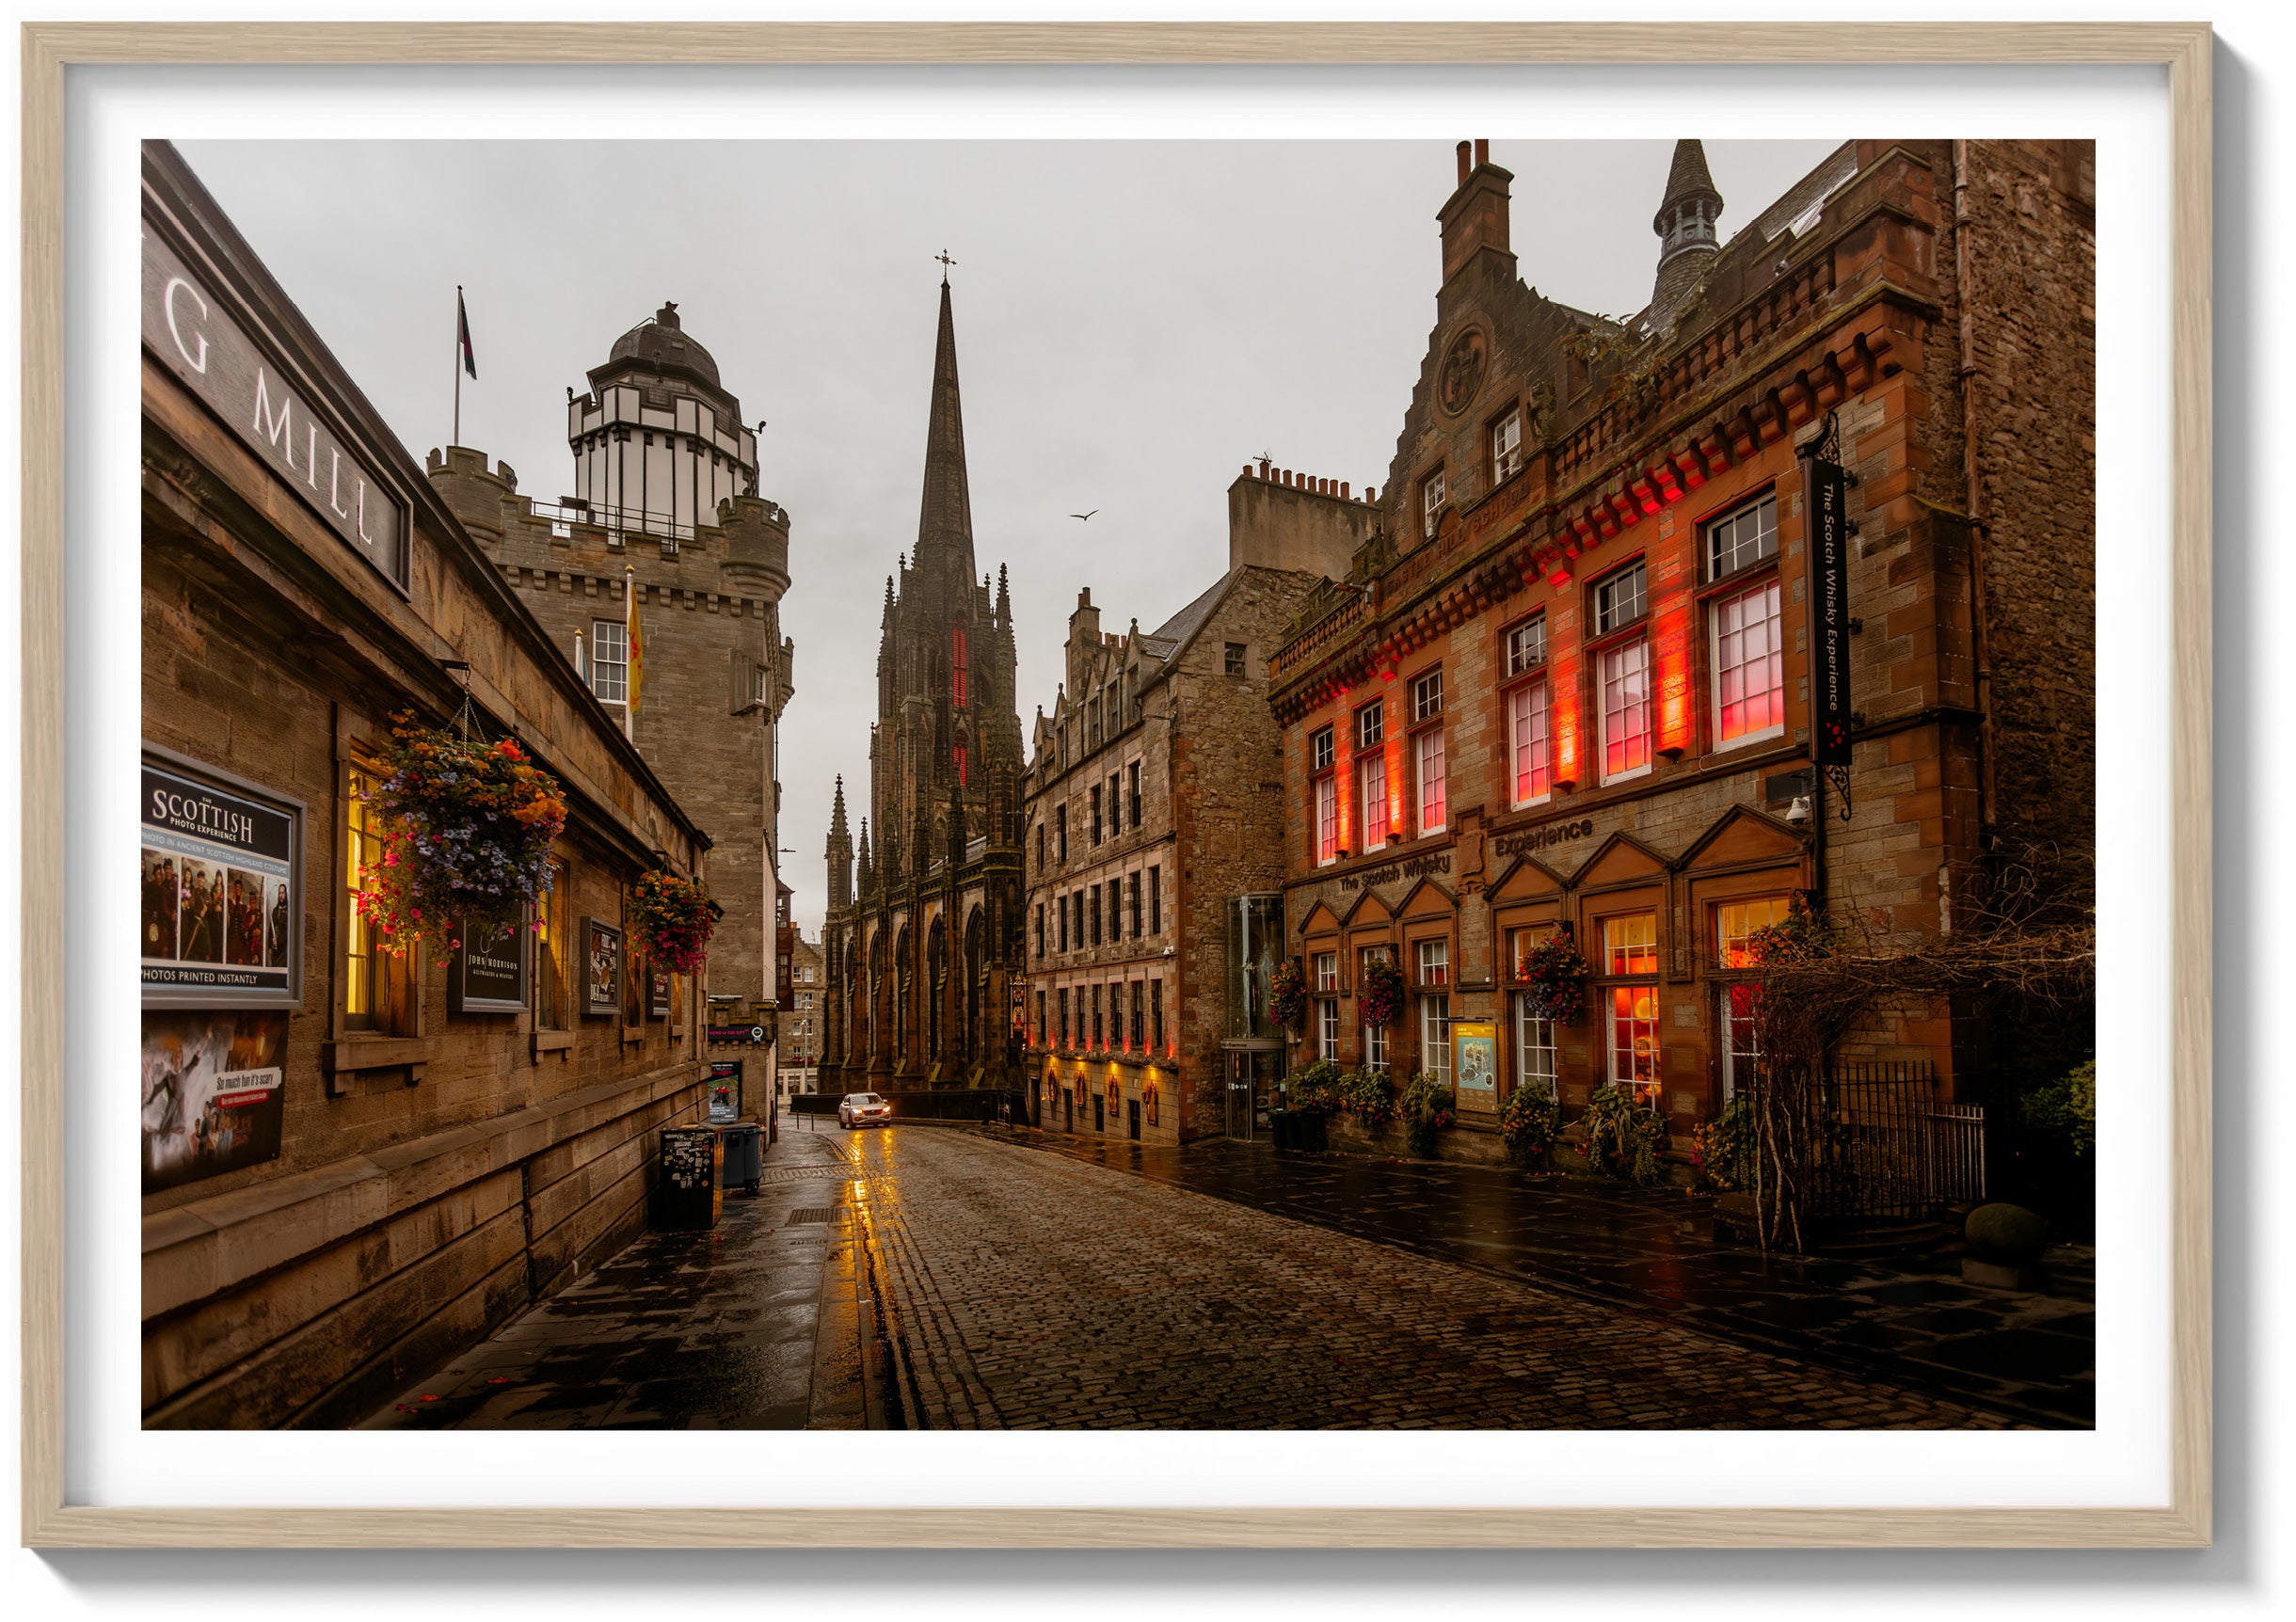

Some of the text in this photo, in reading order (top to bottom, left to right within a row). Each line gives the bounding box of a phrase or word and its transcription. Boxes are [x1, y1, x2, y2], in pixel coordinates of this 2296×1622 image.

[253, 367, 372, 545] MILL
[1388, 484, 1530, 593] CASTLE HILL SCHOOL
[1824, 484, 1840, 711] The Scotch Whisky Experience
[152, 788, 253, 844] SCOTTISH
[169, 817, 237, 842] PHOTO EXPERIENCE
[167, 837, 175, 847] IN
[177, 840, 205, 853] ANCIENT
[206, 847, 235, 862] SCOTTISH
[1340, 818, 1593, 891] The Scotch Whisky Experience
[179, 971, 215, 983] PRINTED
[217, 973, 258, 984] INSTANTLY
[468, 954, 518, 970] JOHN MORRISON
[216, 1073, 274, 1091] So much fun it's scary
